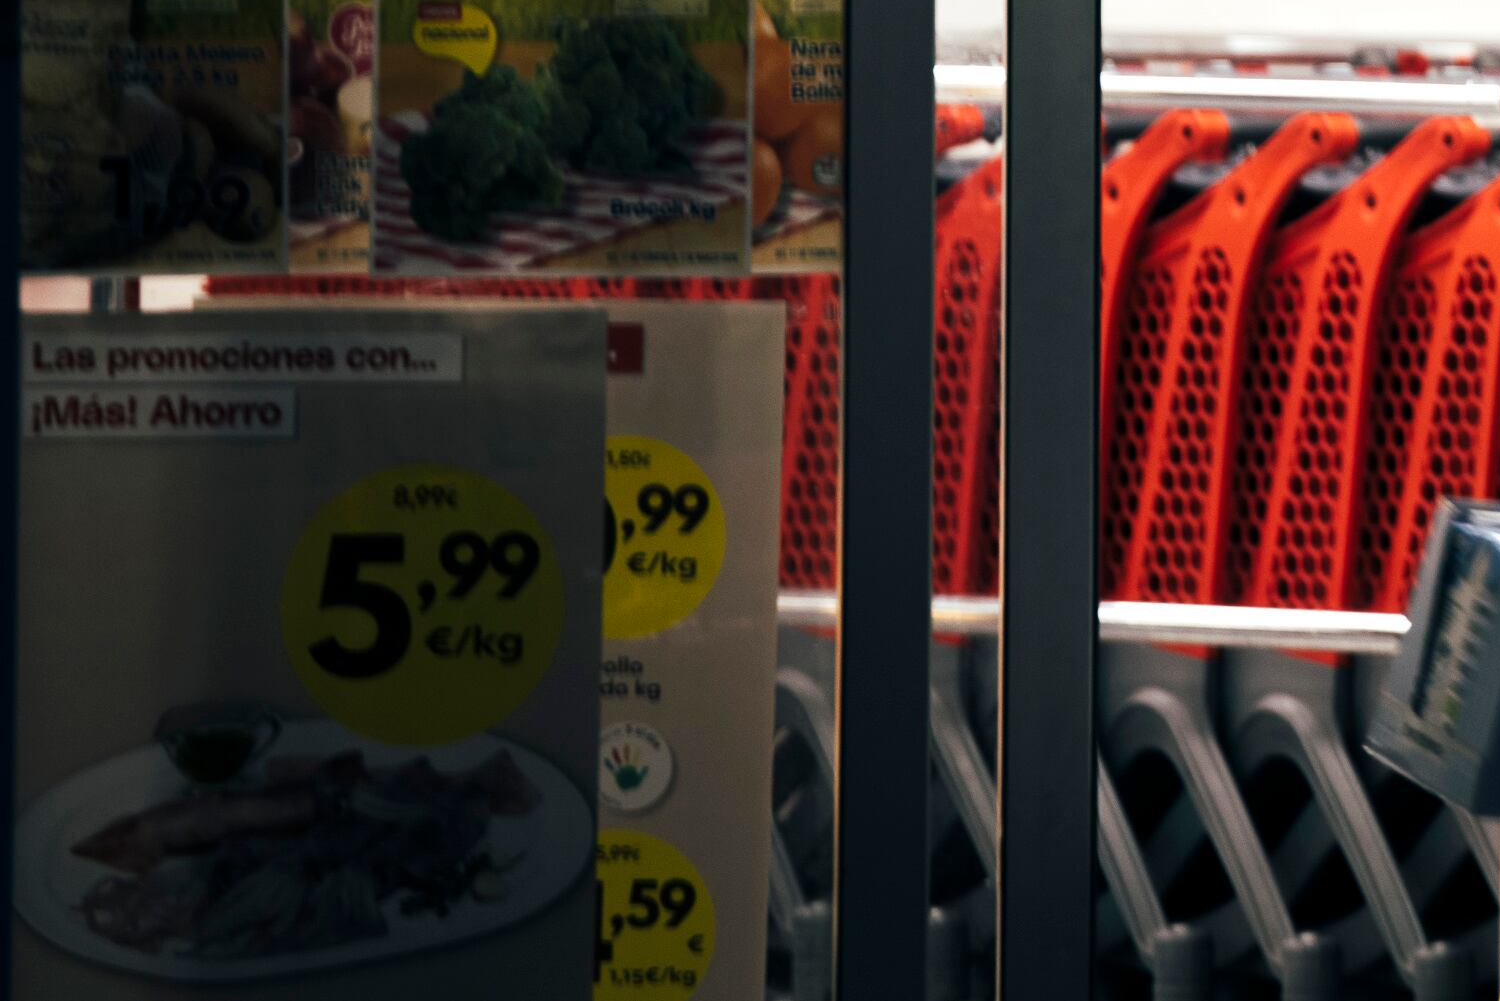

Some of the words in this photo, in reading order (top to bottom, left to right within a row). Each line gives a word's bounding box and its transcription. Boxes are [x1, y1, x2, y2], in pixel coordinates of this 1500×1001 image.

[31, 341, 96, 375] Las
[106, 339, 336, 378] promociones
[346, 341, 438, 373] con...
[31, 392, 138, 433] ¡Más!
[149, 395, 283, 430] Ahorro
[603, 483, 711, 577] ,99
[627, 551, 699, 582] €/kg
[307, 530, 542, 682] 5,99
[425, 624, 525, 667] €/kg
[635, 676, 661, 702] kg
